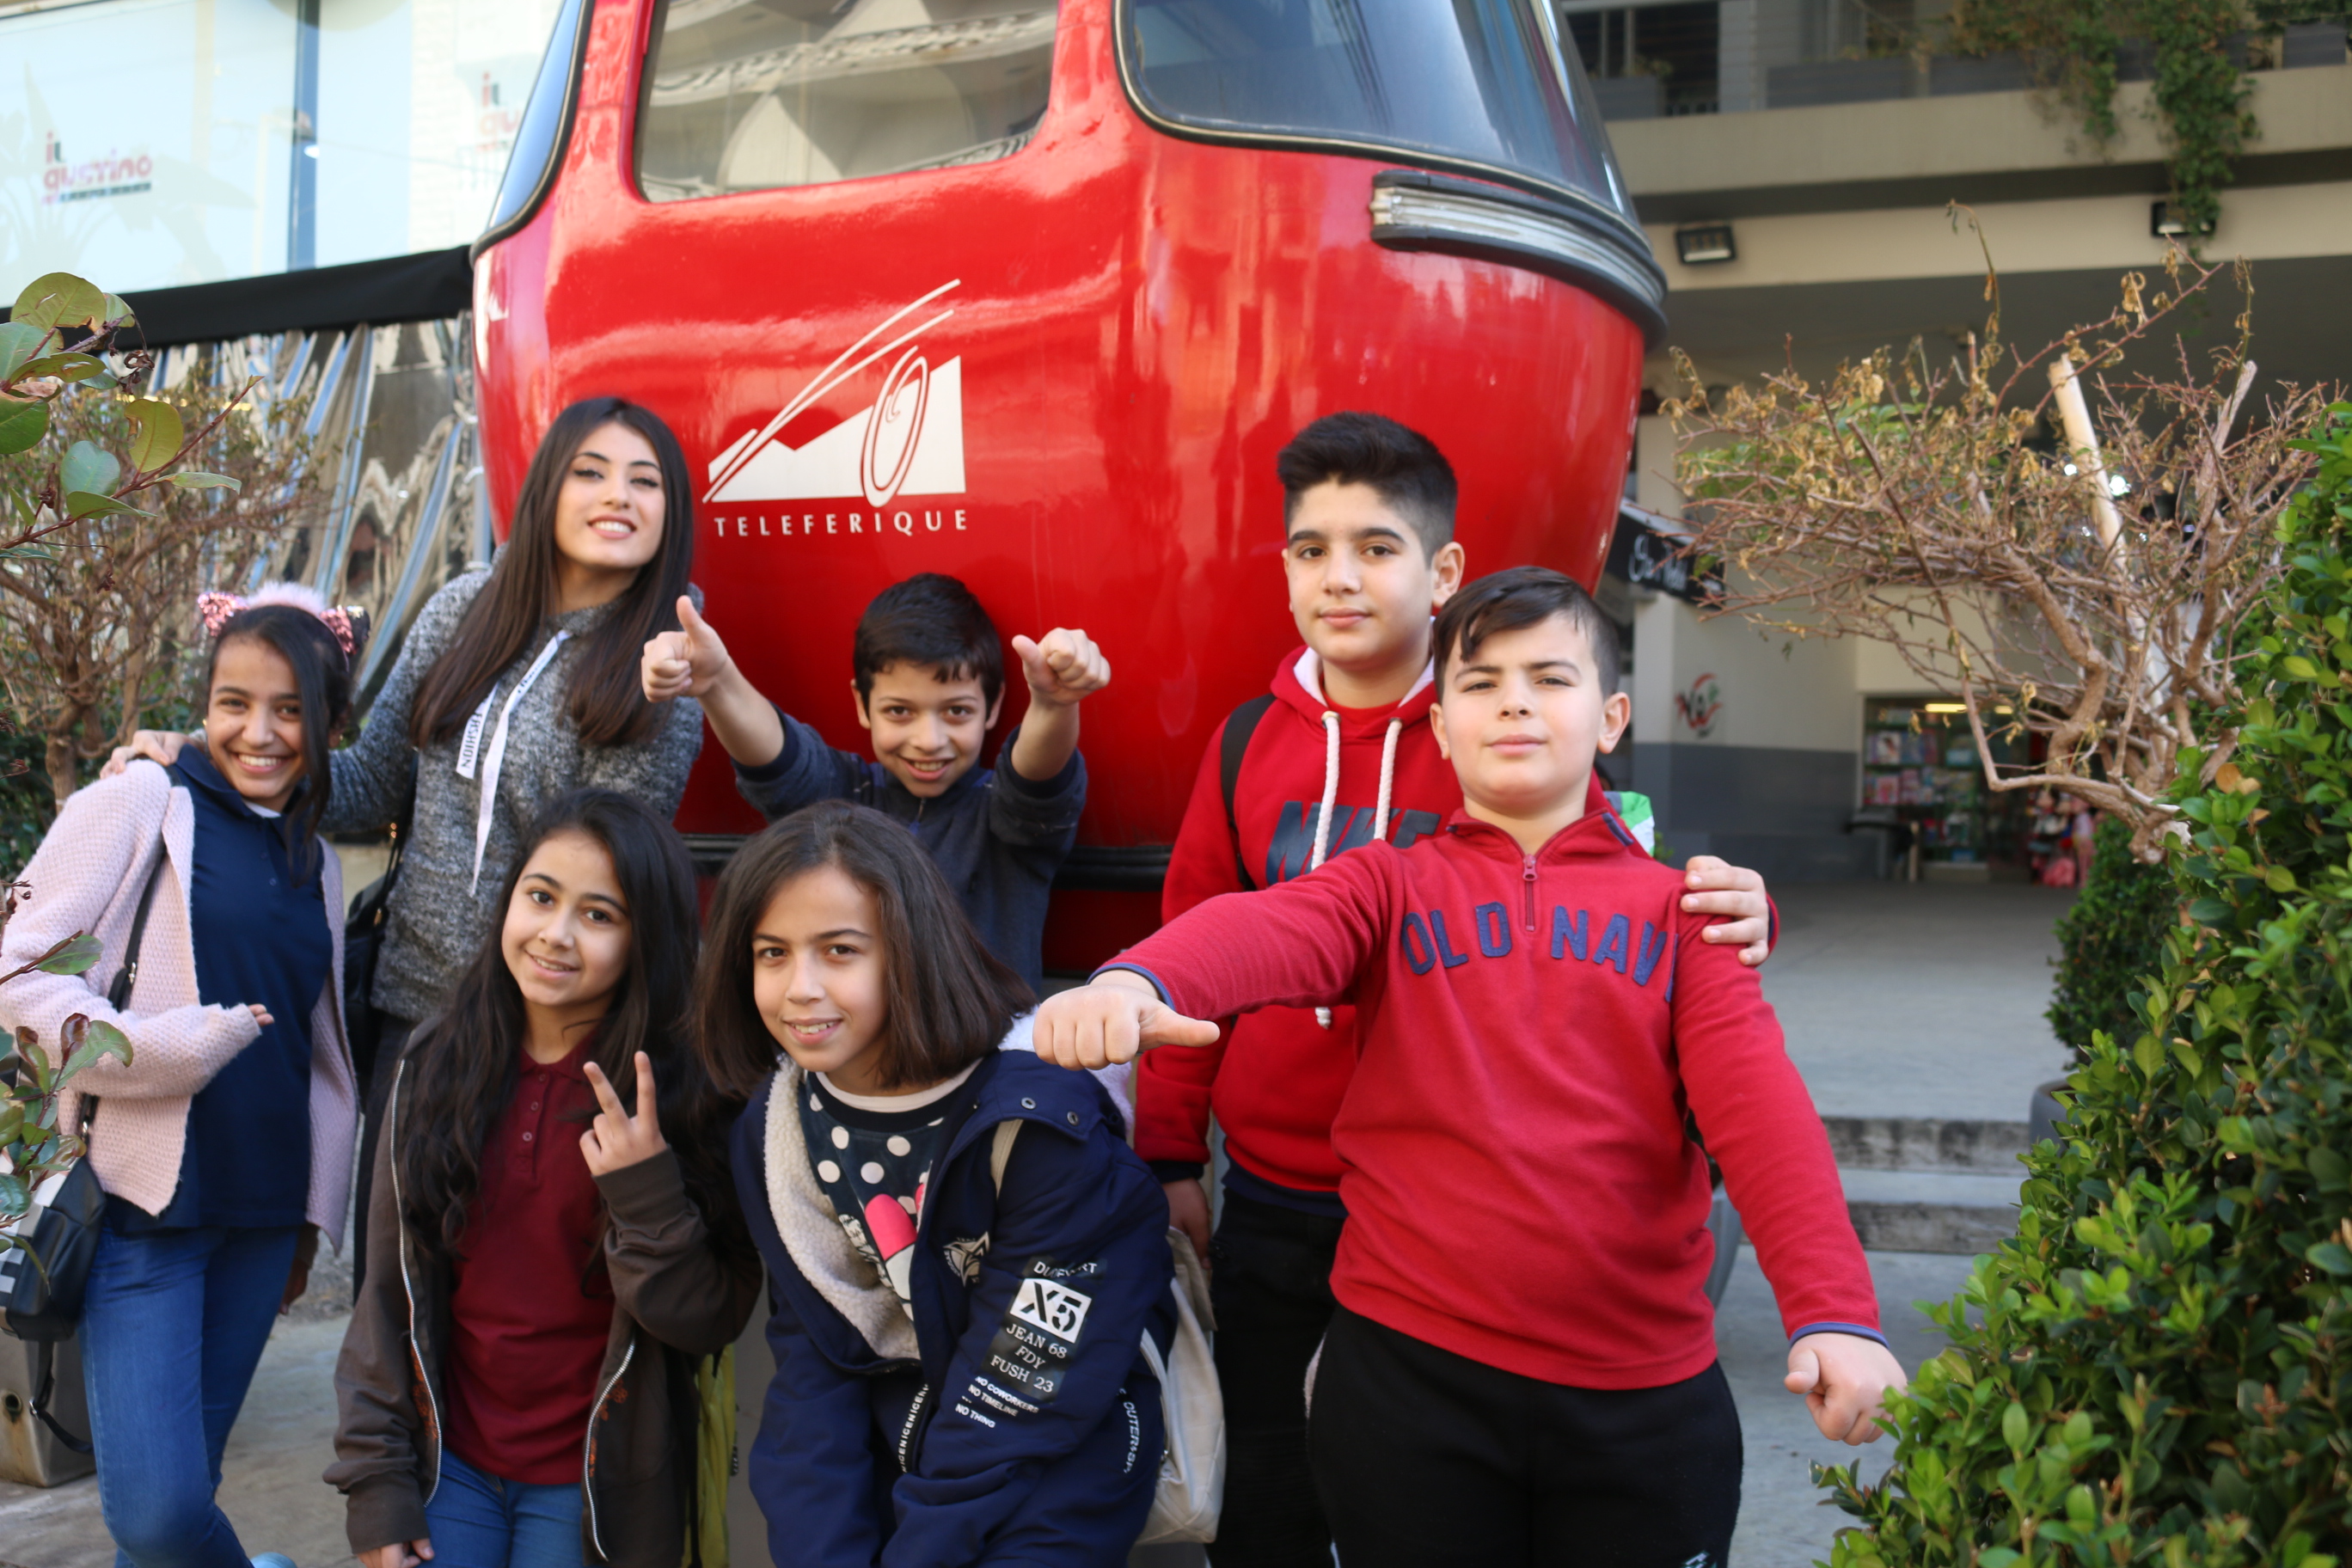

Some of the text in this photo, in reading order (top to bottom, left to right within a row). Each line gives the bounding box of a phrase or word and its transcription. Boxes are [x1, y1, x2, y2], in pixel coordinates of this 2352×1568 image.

[714, 509, 967, 537] TELEFERIQUE
[1400, 901, 1679, 1003] OLD NAV
[1020, 1281, 1082, 1332] X5
[1006, 1323, 1068, 1358] JEAN 68
[1015, 1344, 1046, 1369] FDY
[990, 1354, 1054, 1393] FUSH 23
[968, 1384, 1019, 1417] NO TIMELINE
[975, 1375, 1039, 1413] NO COWORKERS
[955, 1403, 995, 1429] NO THING
